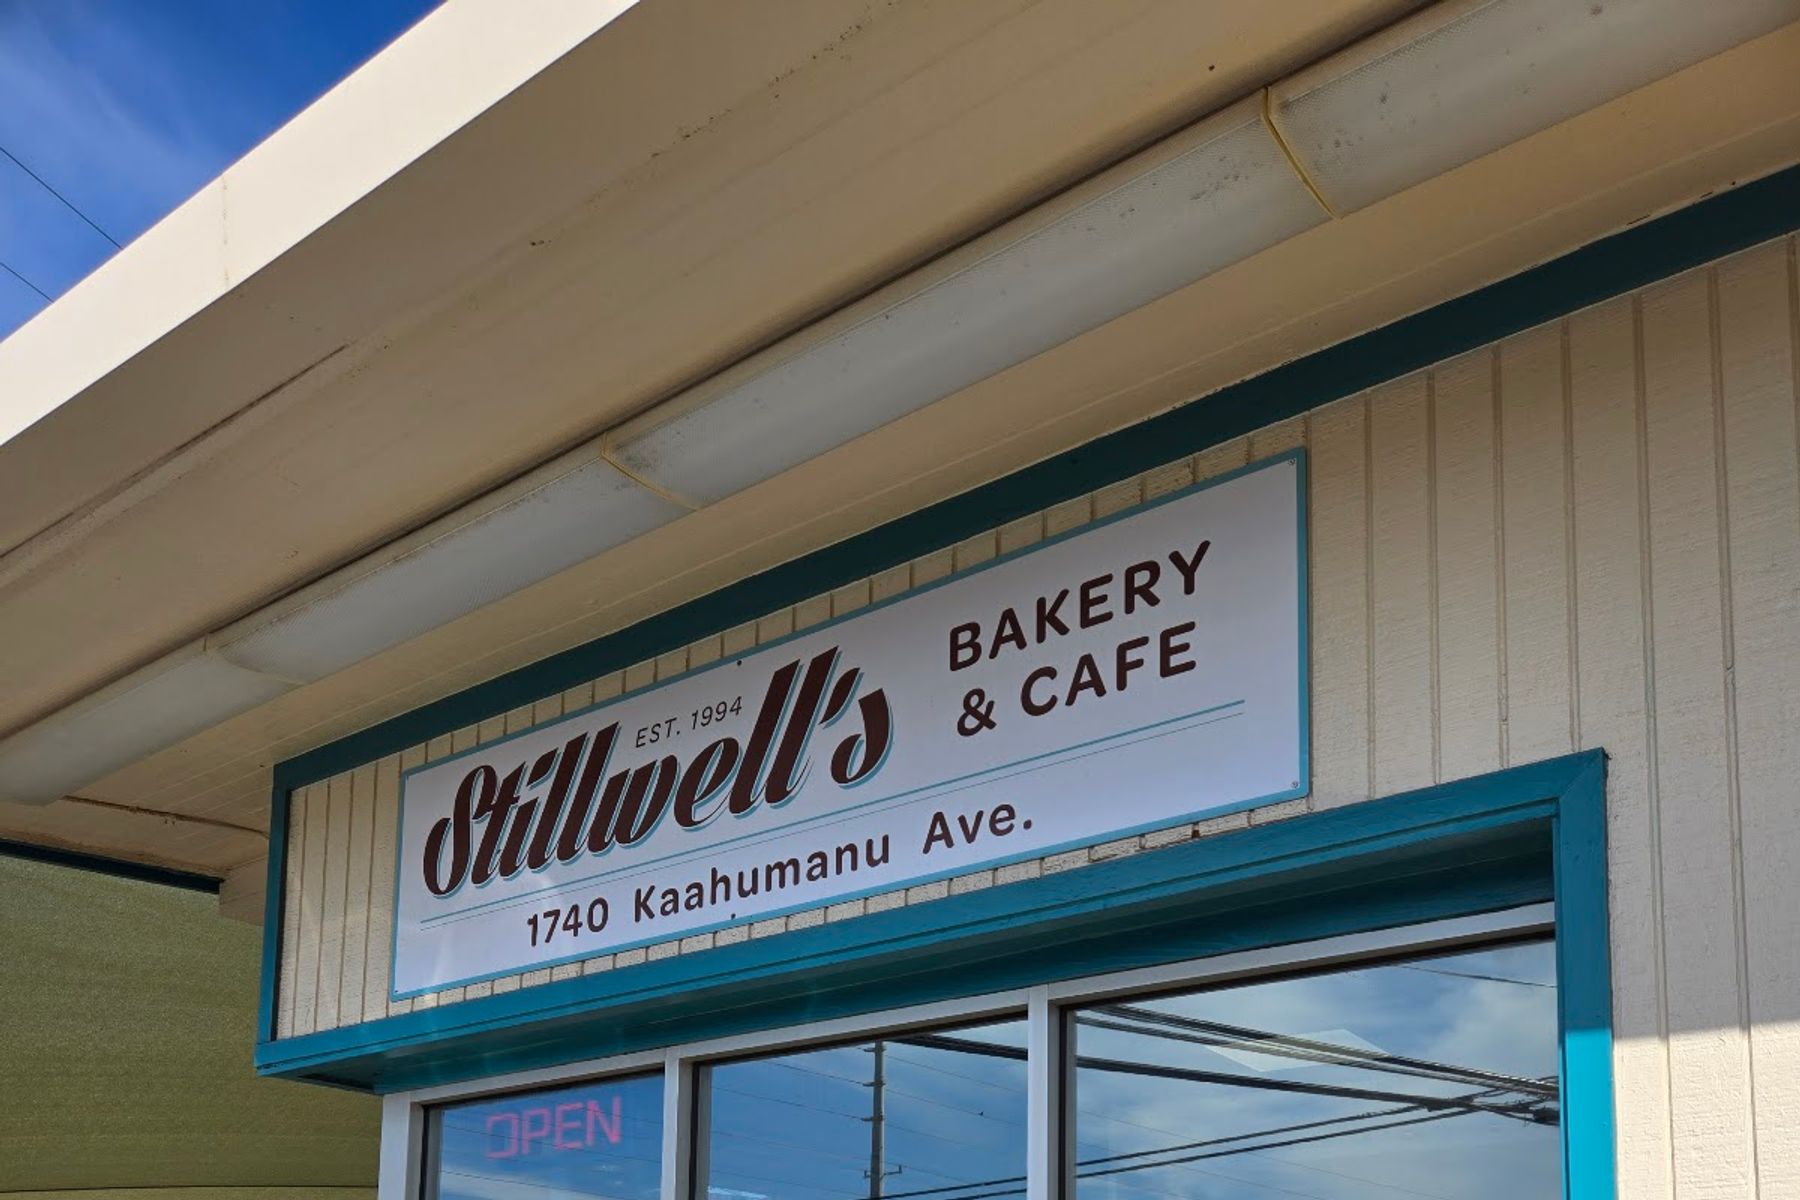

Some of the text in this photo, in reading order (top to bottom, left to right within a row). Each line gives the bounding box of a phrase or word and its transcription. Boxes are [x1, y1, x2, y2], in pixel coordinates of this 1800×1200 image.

[949, 539, 1212, 672] BAKERY
[635, 695, 743, 748] EST. 1994
[956, 621, 1197, 737] & CAFE
[422, 644, 895, 899] Stillwell's
[527, 803, 1033, 947] 1740 Kaahumanu Ave.
[485, 1094, 622, 1161] OPEN
